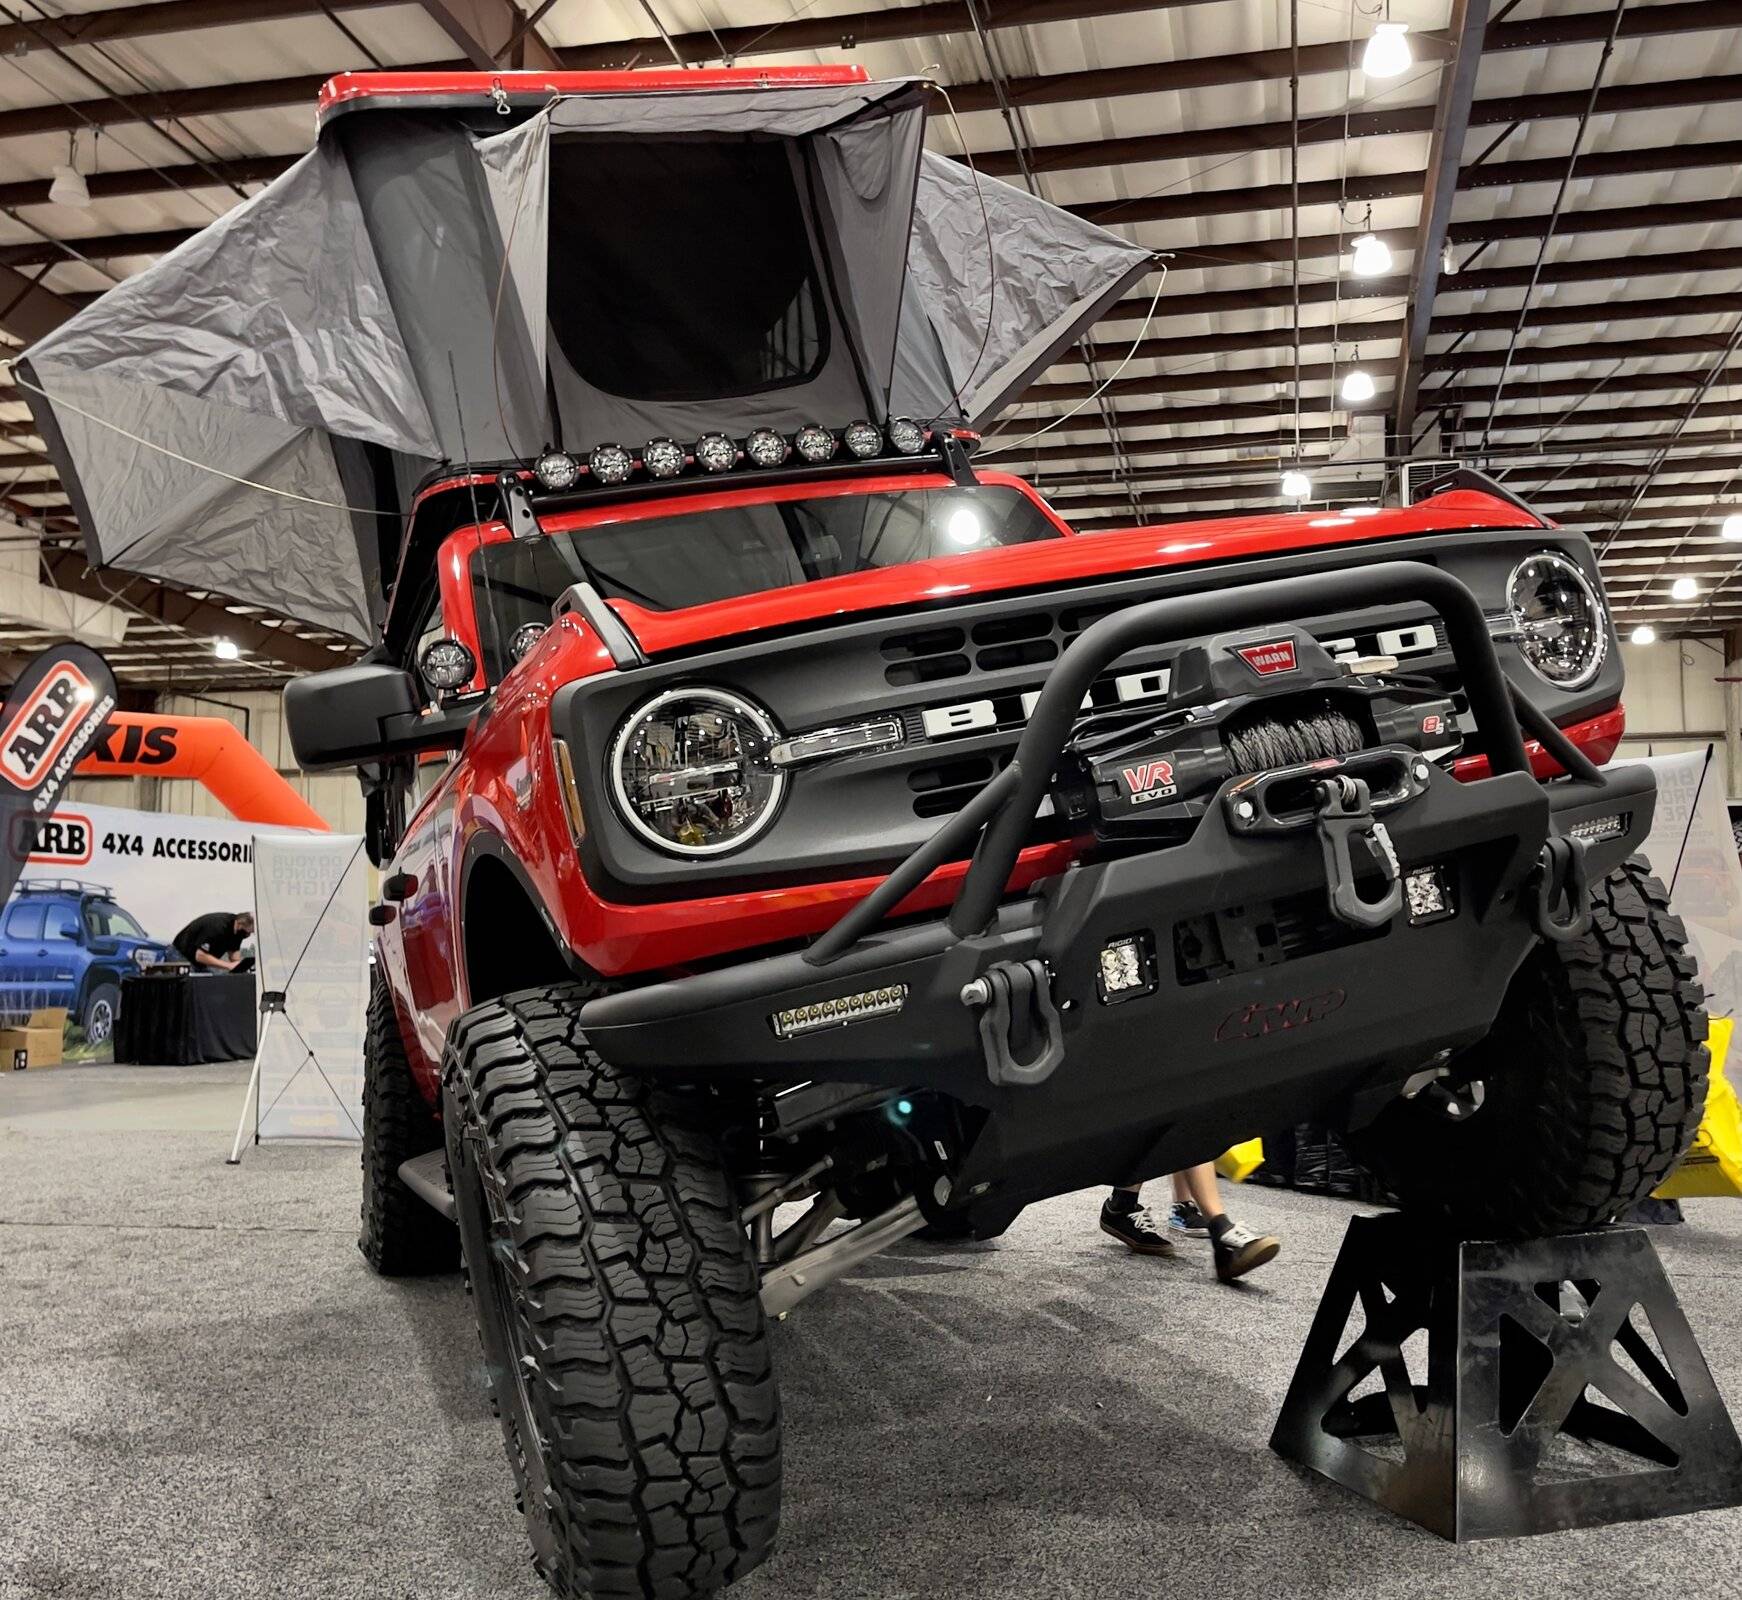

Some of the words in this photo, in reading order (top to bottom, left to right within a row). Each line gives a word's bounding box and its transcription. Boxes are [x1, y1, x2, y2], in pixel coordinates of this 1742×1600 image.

[1252, 651, 1291, 667] WARN
[8, 678, 78, 775] ARB
[1122, 760, 1175, 793] VR
[1134, 787, 1173, 803] EVO
[102, 833, 144, 856] 4X4
